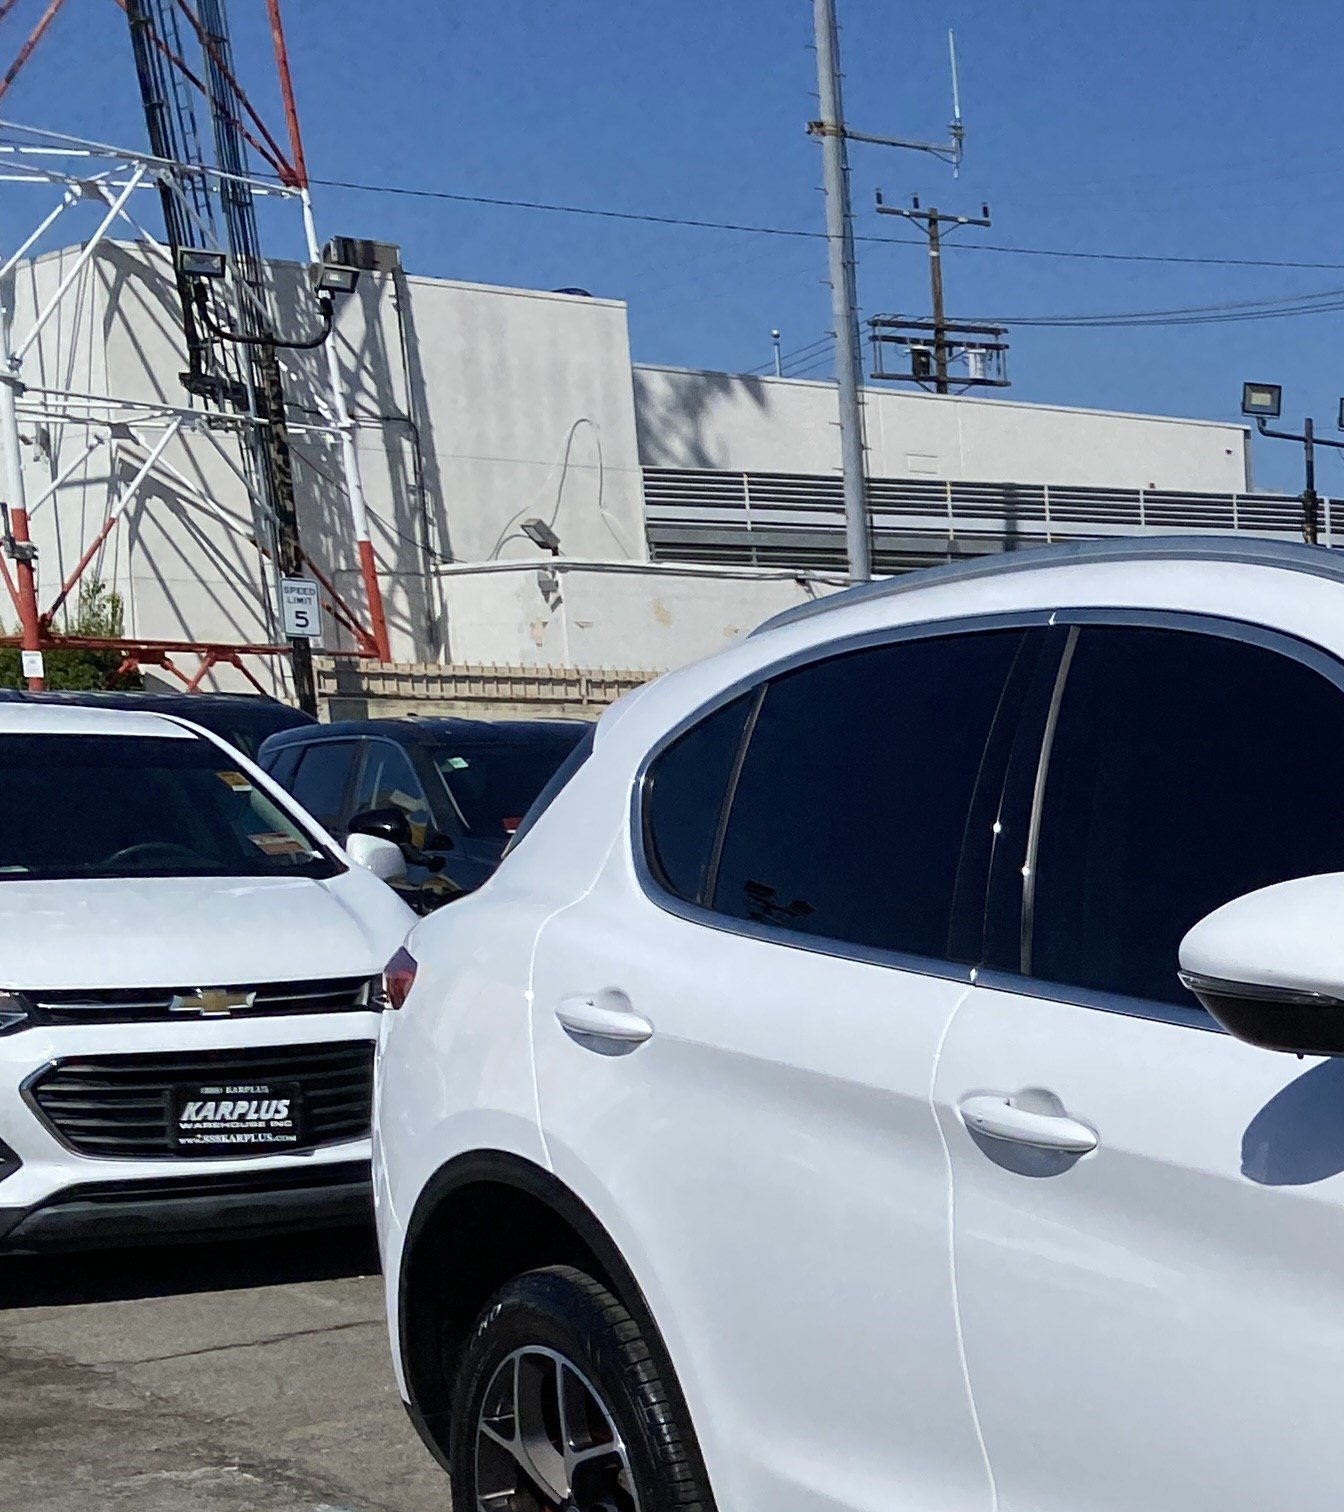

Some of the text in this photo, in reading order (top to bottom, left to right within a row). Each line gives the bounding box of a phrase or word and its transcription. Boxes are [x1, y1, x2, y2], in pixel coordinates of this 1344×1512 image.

[284, 586, 316, 596] SPEED
[288, 597, 312, 605] LIMIT
[295, 610, 310, 628] 5
[180, 1099, 291, 1121] KARPLUS
[179, 1120, 266, 1129] WAREHOUSE
